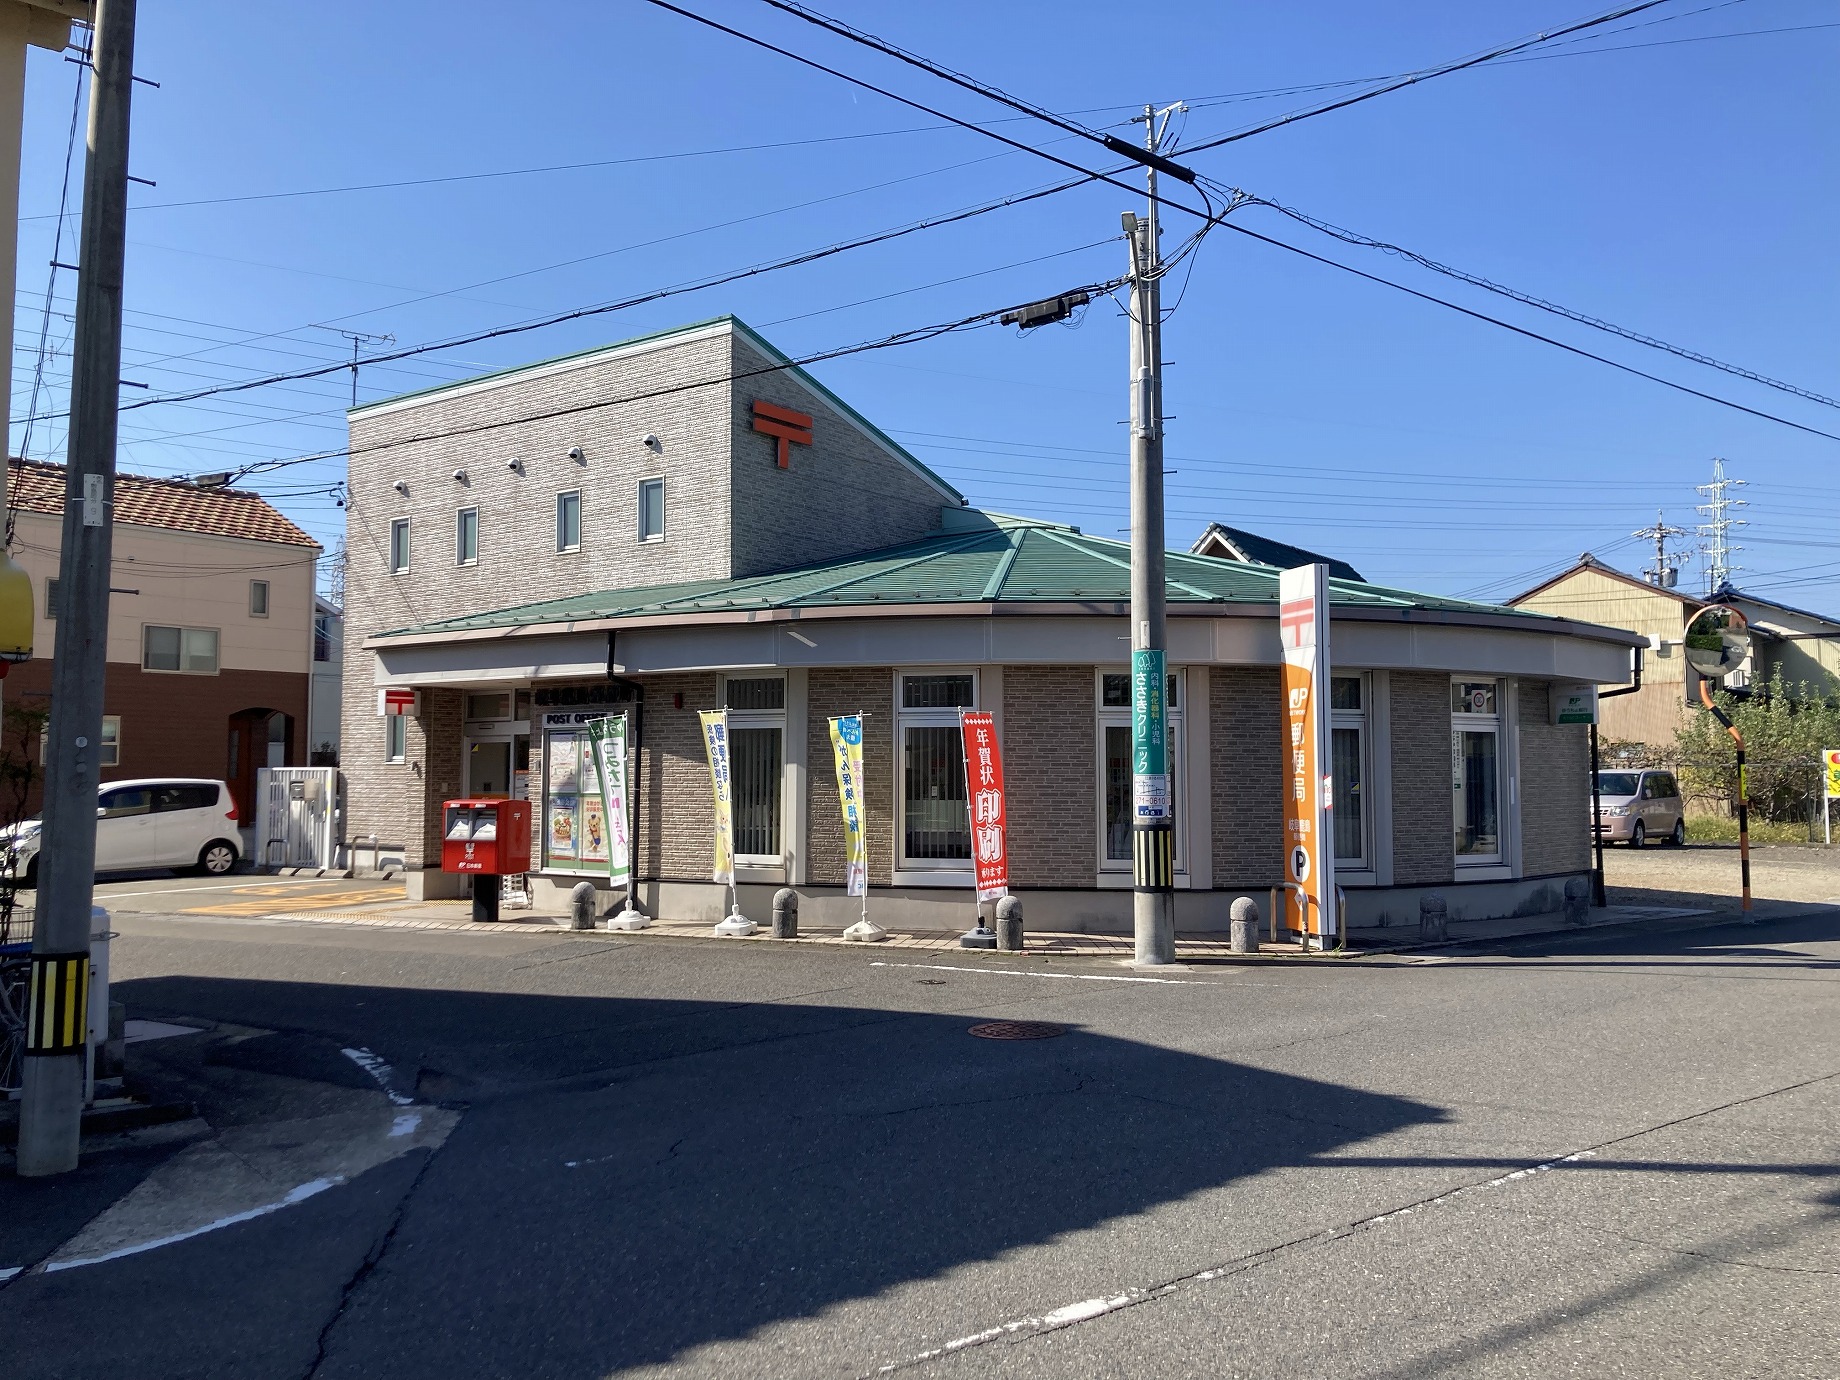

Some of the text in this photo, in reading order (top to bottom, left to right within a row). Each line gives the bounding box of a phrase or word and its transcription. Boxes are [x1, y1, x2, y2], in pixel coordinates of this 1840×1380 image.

[547, 714, 571, 725] POST
[1136, 672, 1148, 773] ささきクリニック
[1150, 672, 1161, 745] 内科・消化器科・小児科
[976, 729, 994, 785] 年賀状
[1291, 722, 1306, 803] 郵便局
[1295, 850, 1306, 877] P
